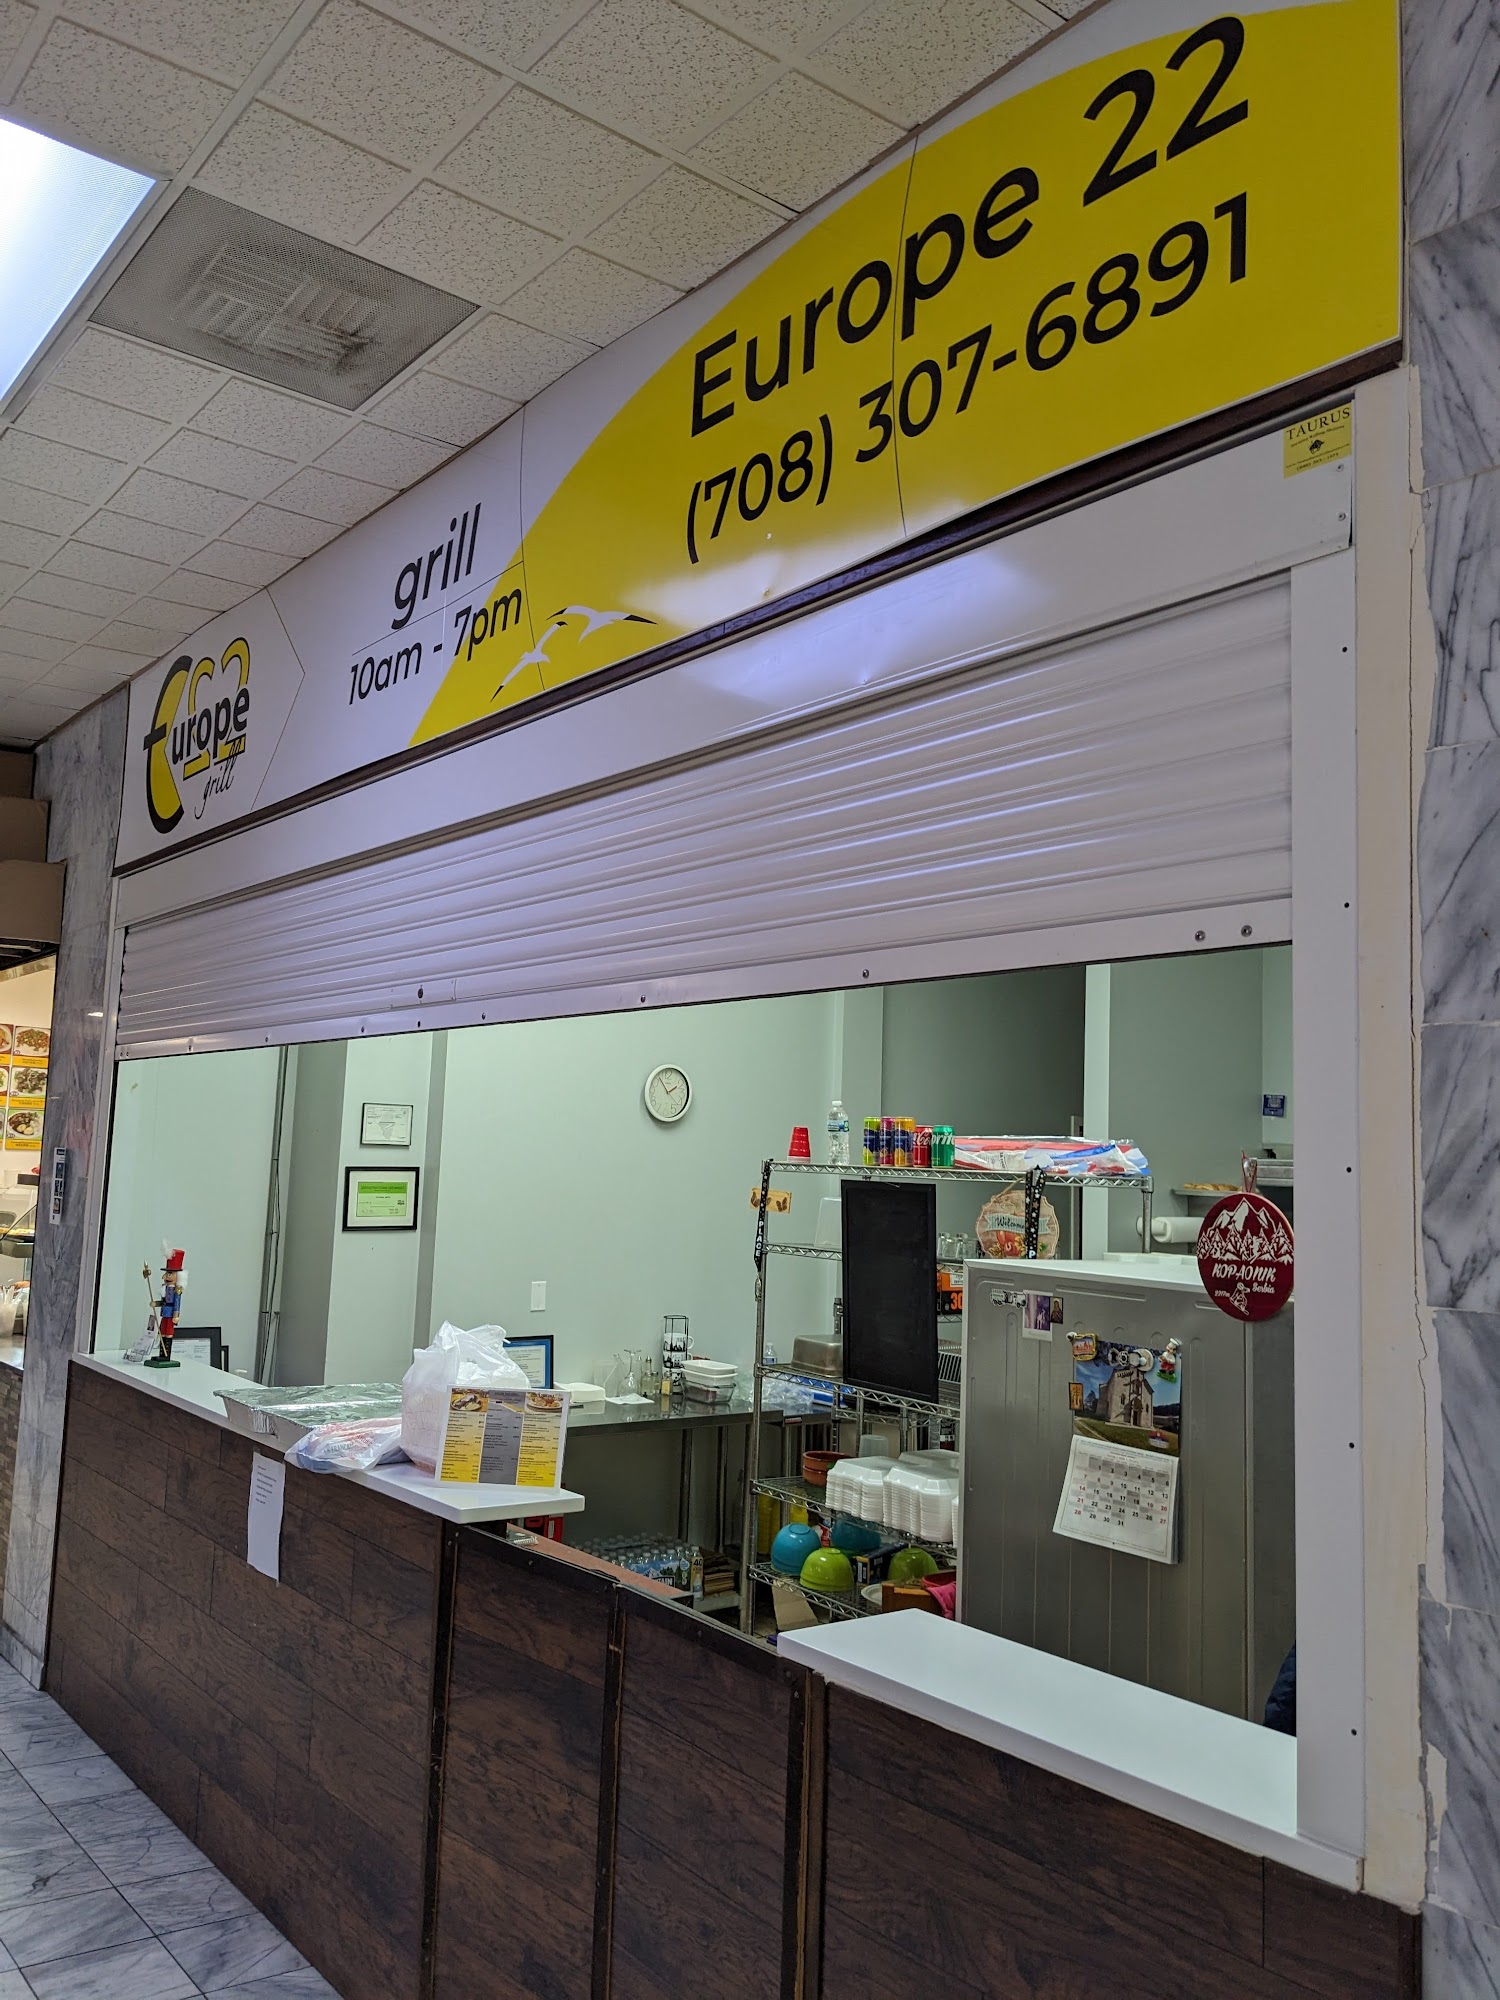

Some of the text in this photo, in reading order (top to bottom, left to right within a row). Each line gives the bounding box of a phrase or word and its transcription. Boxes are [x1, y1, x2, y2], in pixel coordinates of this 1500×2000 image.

[691, 16, 1249, 437] Europe 22
[686, 192, 1248, 564] (708) 307-6891
[1286, 407, 1350, 440] TAURUS
[391, 502, 482, 630] grill
[349, 642, 422, 706] 10am
[454, 588, 522, 662] 7pm
[195, 738, 241, 820] grill
[756, 1221, 764, 1256] PLACE
[1212, 1263, 1276, 1282] KOPAONIK
[1252, 1281, 1275, 1294] Serbia
